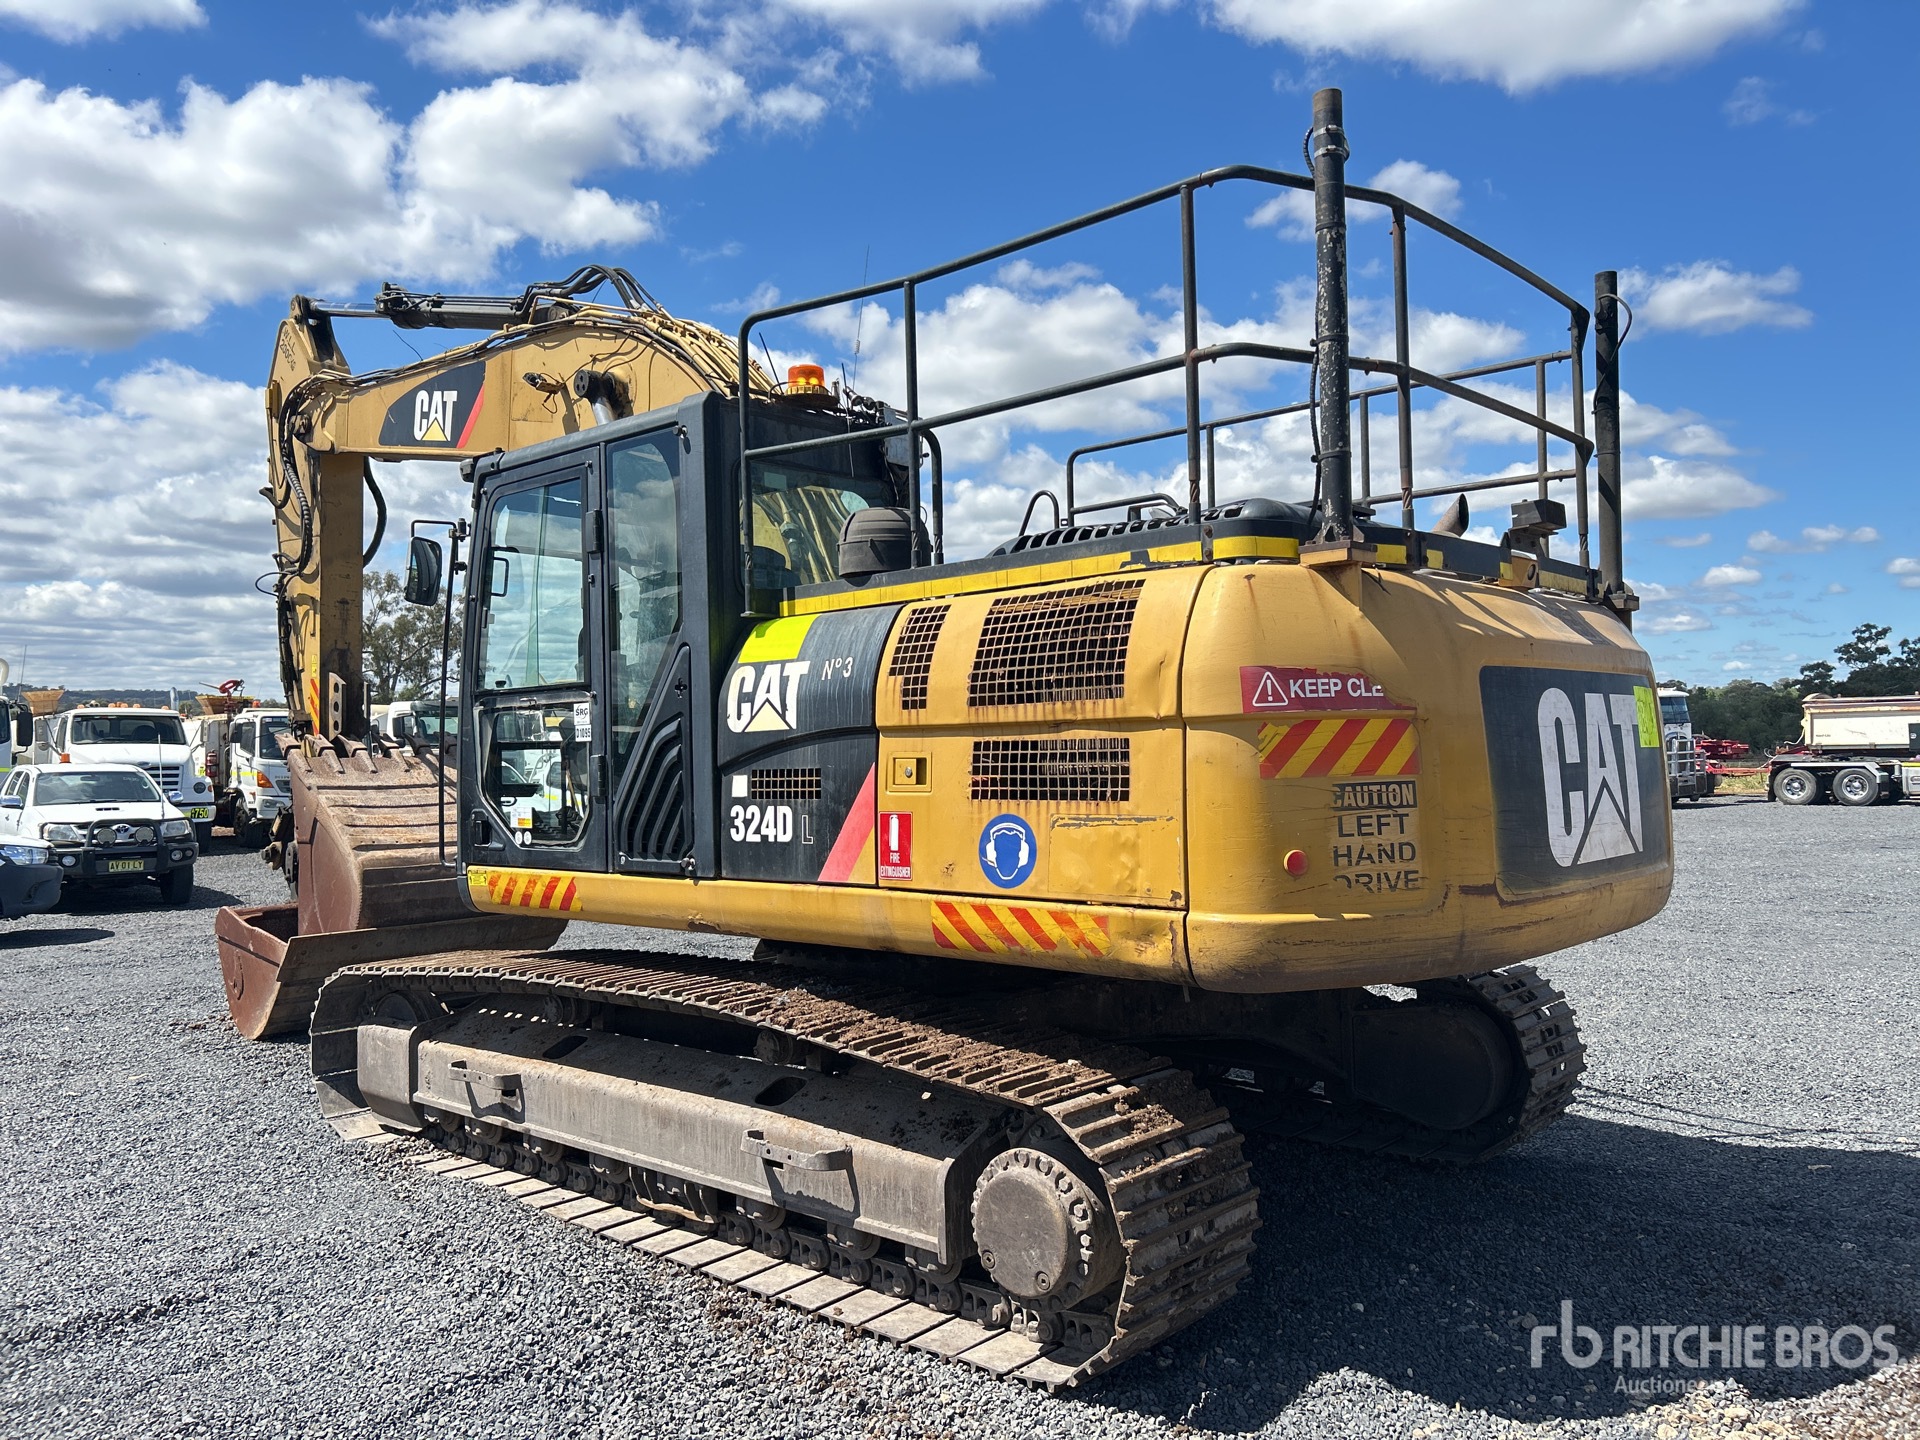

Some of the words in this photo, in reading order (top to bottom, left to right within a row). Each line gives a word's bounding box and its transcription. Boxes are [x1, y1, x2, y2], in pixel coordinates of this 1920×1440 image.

[414, 390, 457, 441] CAT
[726, 661, 809, 733] CAT
[1289, 678, 1342, 699] KEEP
[575, 707, 589, 716] SRG
[1537, 686, 1643, 868] CAT
[1331, 782, 1415, 808] CAUTION
[729, 804, 793, 843] 324D
[1337, 813, 1410, 838] LEFT
[889, 852, 901, 864] FIRE
[1332, 841, 1417, 867] HAND
